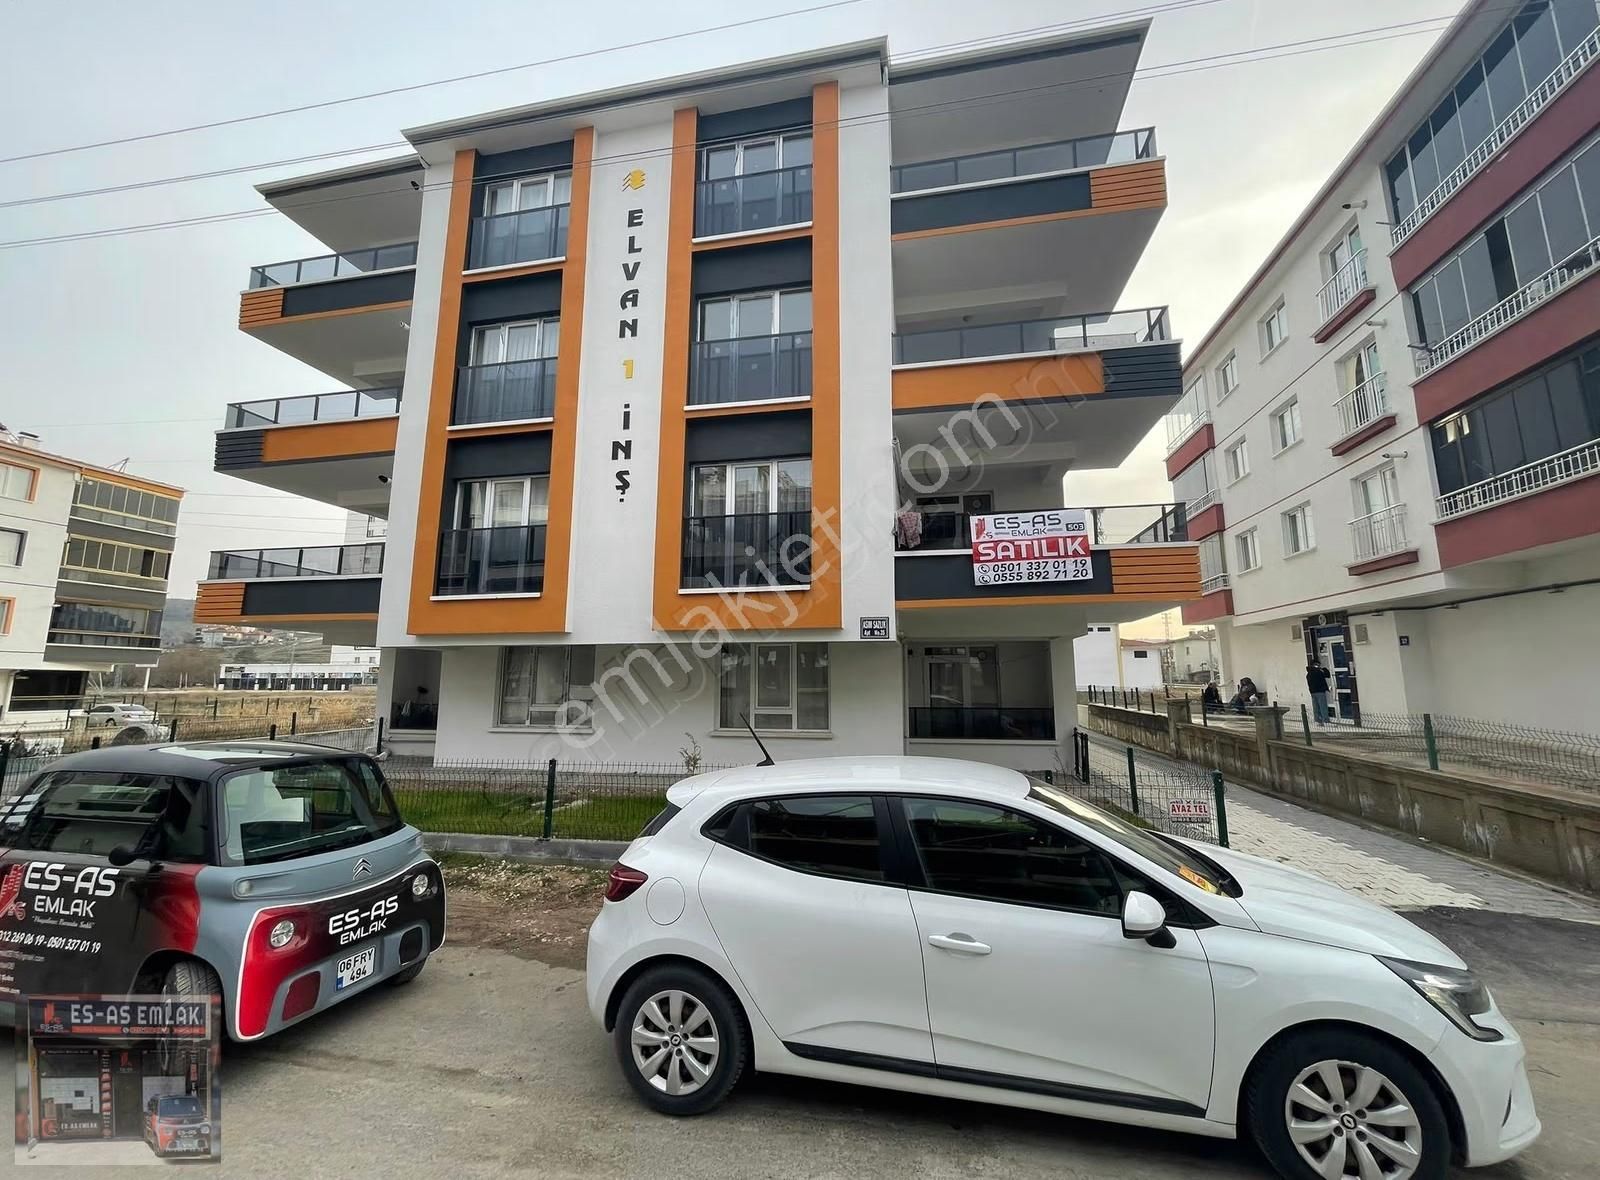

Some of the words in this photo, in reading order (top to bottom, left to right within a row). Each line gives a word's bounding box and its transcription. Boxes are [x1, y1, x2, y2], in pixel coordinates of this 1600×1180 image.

[618, 208, 644, 339] ELVAN
[622, 359, 634, 379] 1
[993, 513, 1061, 529] ES-AS
[1011, 527, 1047, 537] EMLAK
[978, 537, 1086, 561] SATILIK
[993, 563, 1021, 572] 0501
[1026, 561, 1049, 571] 337
[1053, 560, 1067, 569] 01
[1073, 559, 1087, 568] 19
[993, 572, 1023, 582] 0555
[1027, 571, 1050, 580] 892
[1054, 570, 1067, 579] 71
[1073, 568, 1088, 578] 20
[1171, 804, 1192, 813] AYAZ
[1194, 804, 1208, 813] TEL
[24, 861, 120, 897] ES-AS
[34, 895, 96, 918] EMLAK
[329, 895, 399, 935] ES-AS
[11, 931, 26, 944] 269
[23, 933, 34, 945] 06
[34, 934, 45, 946] 19
[65, 938, 82, 951] 337
[79, 940, 91, 952] 01
[91, 942, 102, 954] 19
[340, 918, 387, 945] EMLAK
[340, 959, 352, 973] 06
[353, 949, 374, 967] FRY
[350, 966, 367, 981] 494
